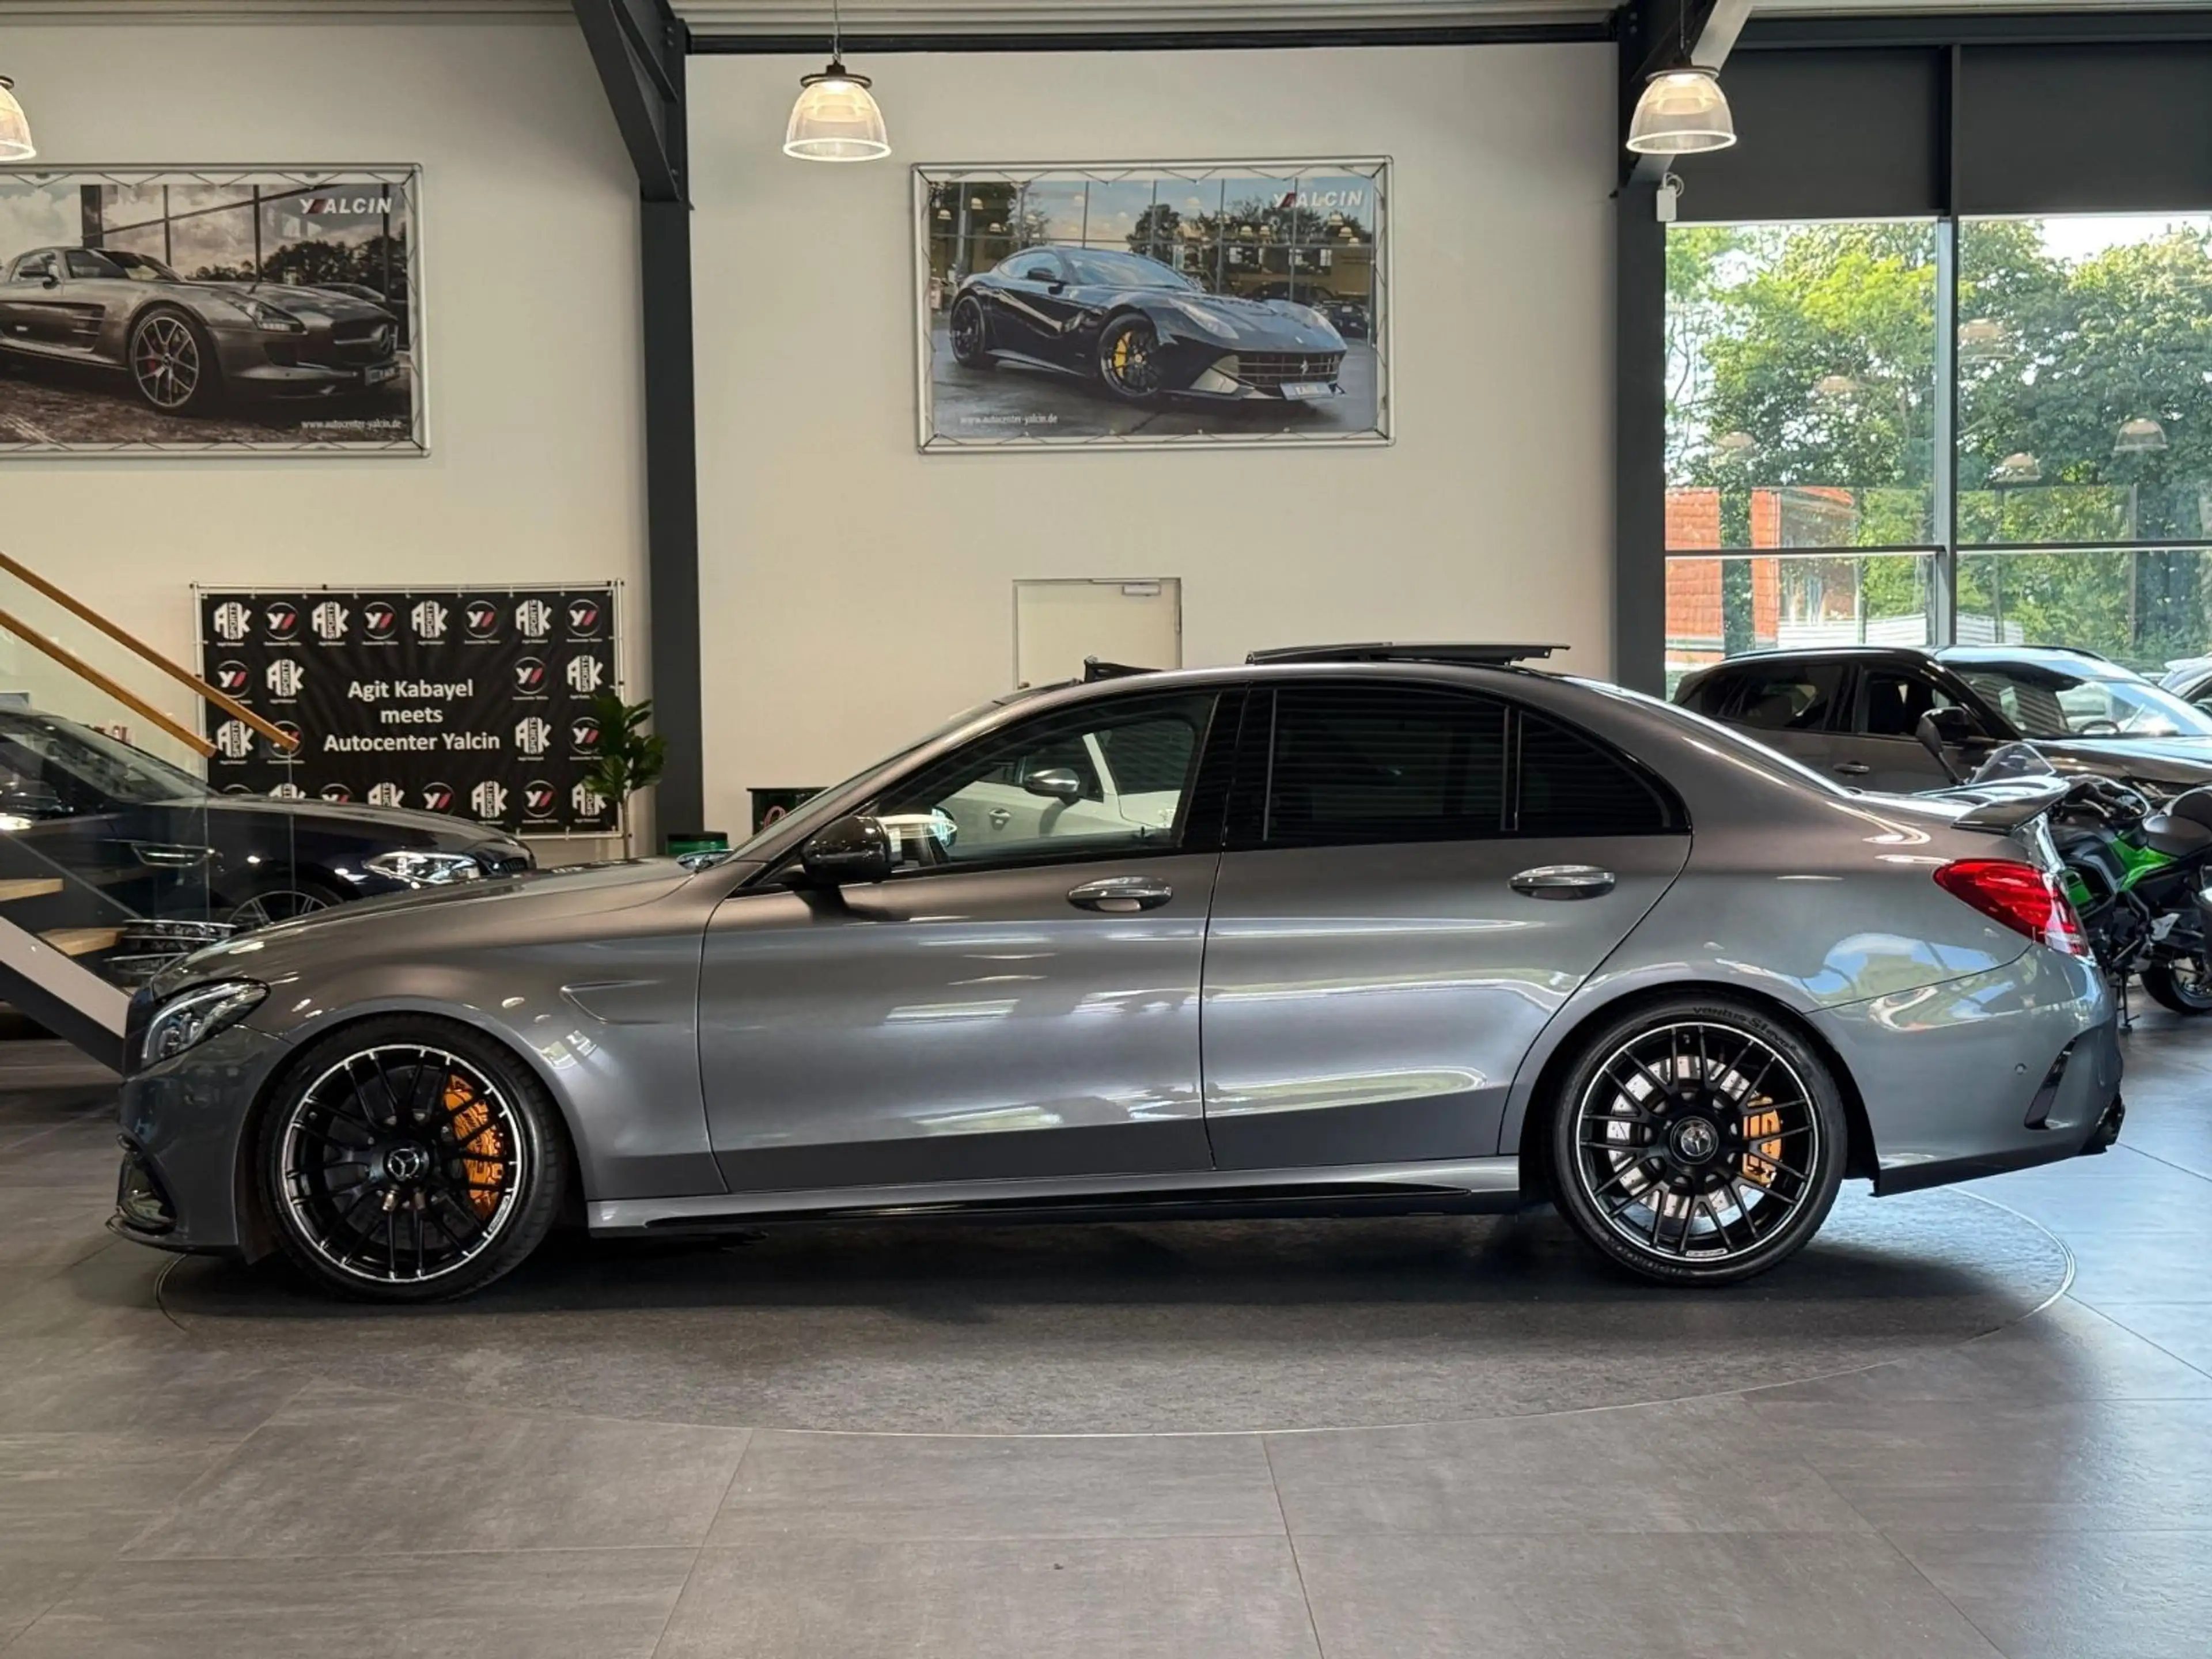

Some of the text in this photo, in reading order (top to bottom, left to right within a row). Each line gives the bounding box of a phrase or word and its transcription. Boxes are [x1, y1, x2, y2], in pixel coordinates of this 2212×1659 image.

[348, 679, 473, 702] Agit Kabayel
[381, 707, 443, 724] meets
[324, 732, 500, 752] Autocenter Yalcin
